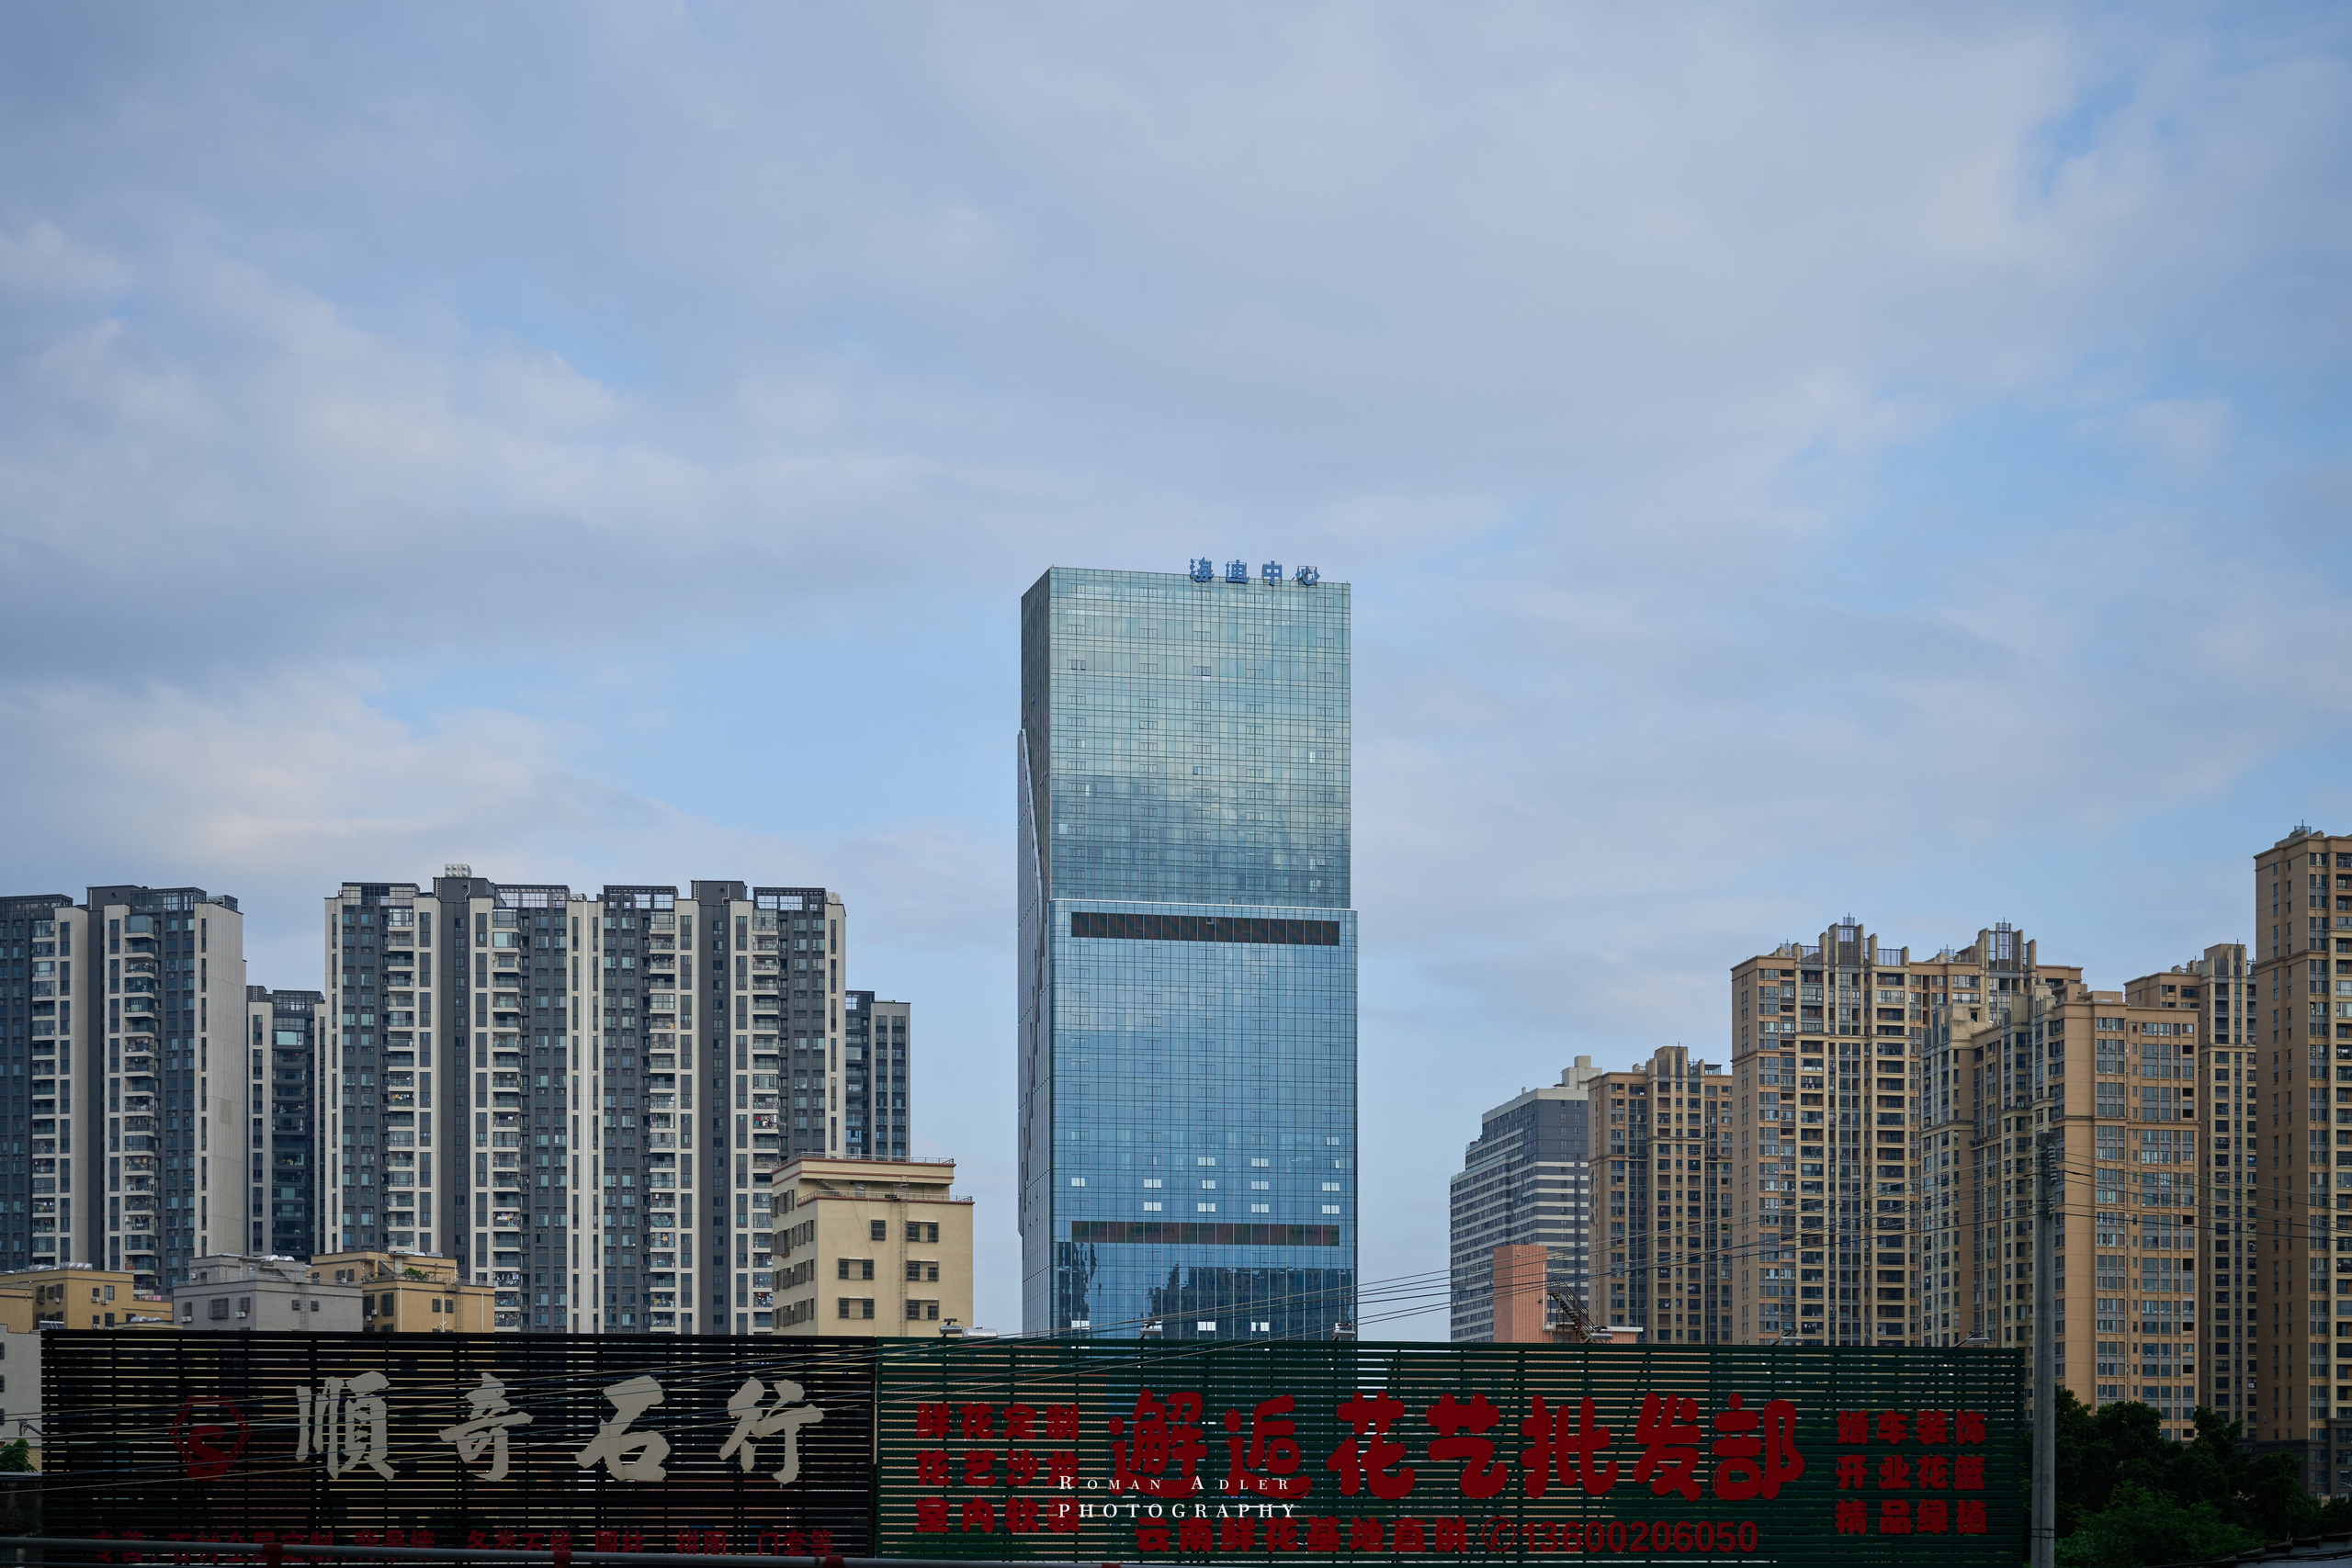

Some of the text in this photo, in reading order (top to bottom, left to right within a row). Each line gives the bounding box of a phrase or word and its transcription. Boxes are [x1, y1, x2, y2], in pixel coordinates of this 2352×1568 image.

[916, 1402, 1080, 1440] 鲜花定制
[1837, 1409, 1986, 1445] 婚车装饰
[1107, 1388, 1805, 1502] 邂逅花艺批发部
[915, 1449, 1081, 1487] 花艺沙龙
[1836, 1454, 1986, 1490] 开业花篮
[915, 1496, 1082, 1534] 室内软装
[1836, 1499, 1987, 1535] 精品绿植
[1135, 1516, 1758, 1552] 云南鲜花基地直供 13600206050
